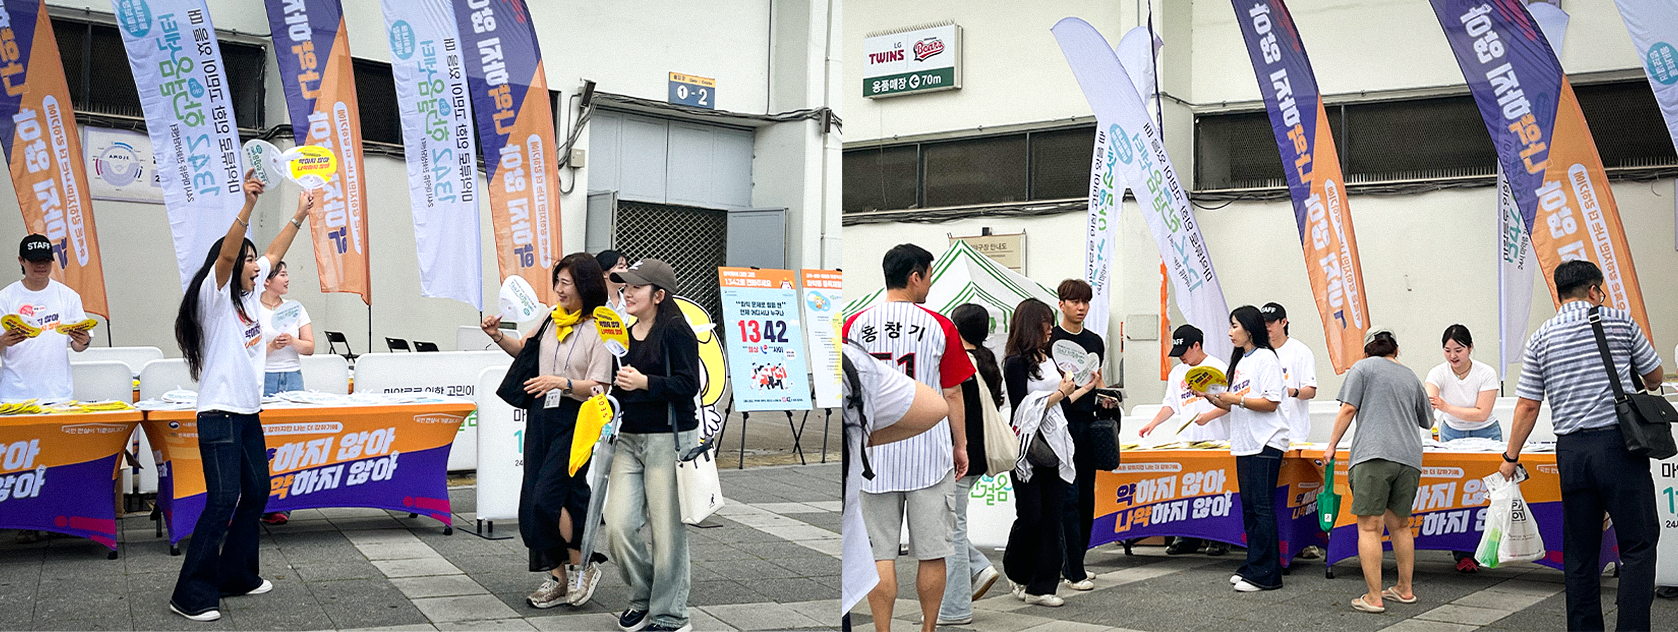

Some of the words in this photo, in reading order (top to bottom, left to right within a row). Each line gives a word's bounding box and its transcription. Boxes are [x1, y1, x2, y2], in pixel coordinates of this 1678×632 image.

[869, 50, 904, 64] TWINS
[916, 41, 945, 56] Bears
[872, 78, 906, 93] 용품매장
[922, 74, 941, 85] 70m
[28, 242, 51, 250] STAFF
[446, 385, 474, 396] 고민이
[0, 439, 40, 470] 아
[337, 427, 396, 461] 않아
[269, 464, 344, 500] 약하지
[346, 450, 400, 486] 않아
[1116, 475, 1177, 506] 약하지
[1181, 468, 1226, 497] 않아
[1114, 500, 1188, 533] 나약하지
[1192, 489, 1233, 519] 않아
[1412, 482, 1457, 512] 하지
[1405, 509, 1470, 538] 약하지
